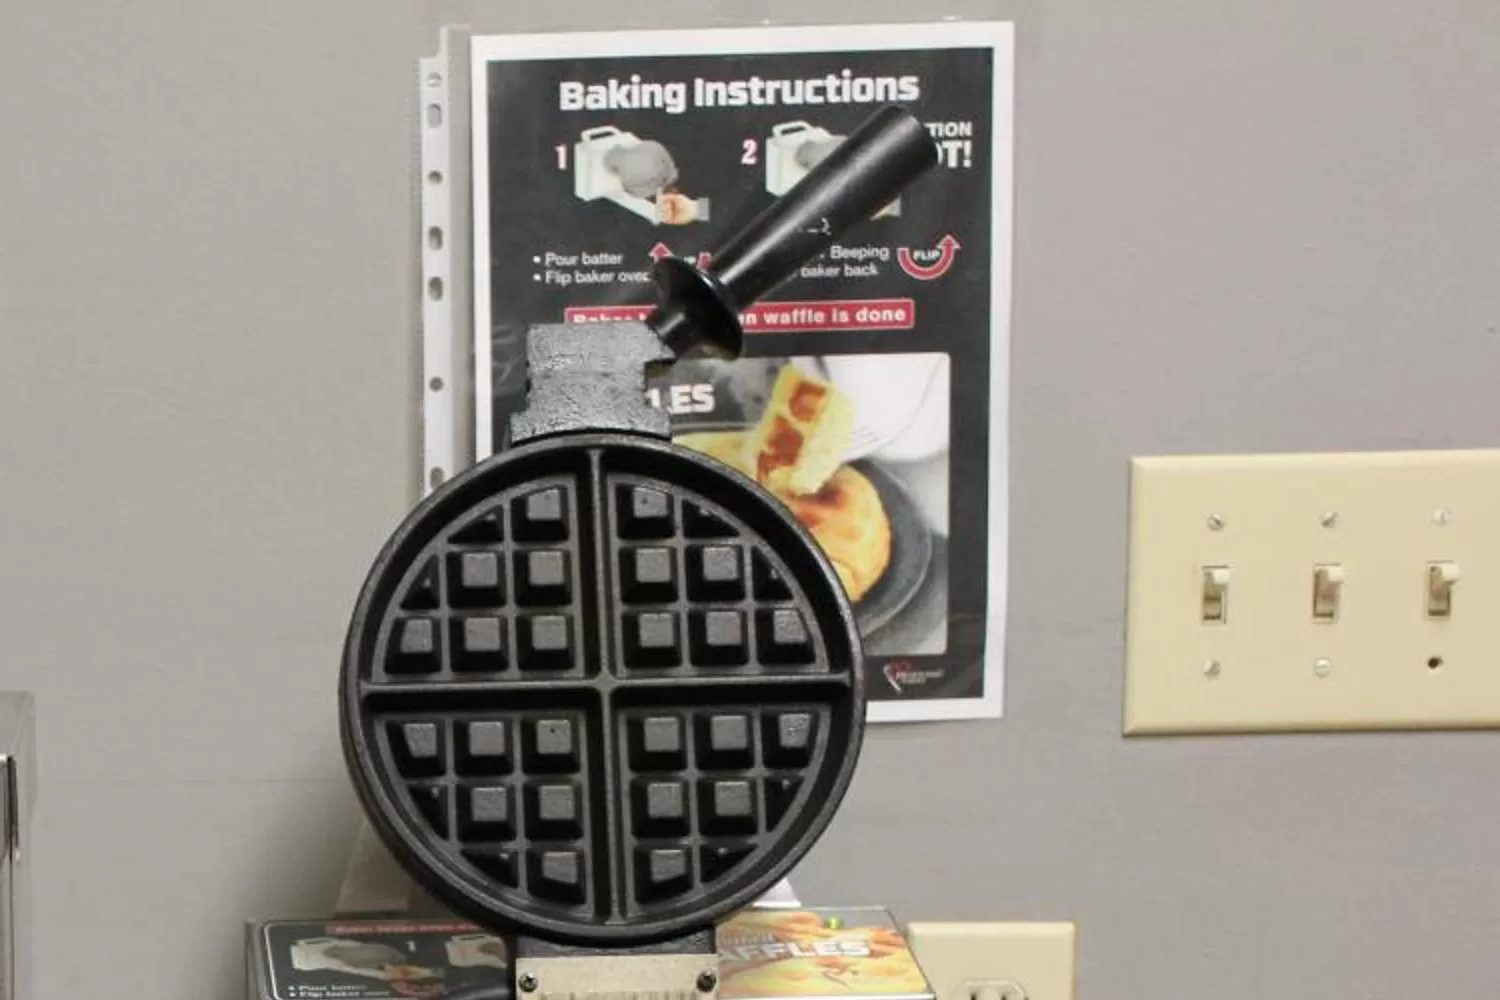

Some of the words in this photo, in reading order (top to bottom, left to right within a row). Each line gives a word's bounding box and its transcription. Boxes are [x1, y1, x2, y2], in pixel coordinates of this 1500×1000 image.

[559, 74, 687, 114] Baking
[694, 69, 920, 107] Instructions
[924, 121, 973, 137] TION
[556, 145, 567, 170] 1
[741, 139, 757, 165] 2
[934, 140, 972, 168] T!
[545, 252, 579, 266] Pour
[581, 251, 623, 265] batter
[830, 245, 889, 261] Beeping
[912, 249, 940, 261] FLIP
[545, 270, 572, 287] Flip
[574, 269, 616, 283] baker
[843, 262, 878, 277] back
[763, 308, 825, 324] waffle
[831, 308, 849, 322] is
[855, 307, 906, 322] done
